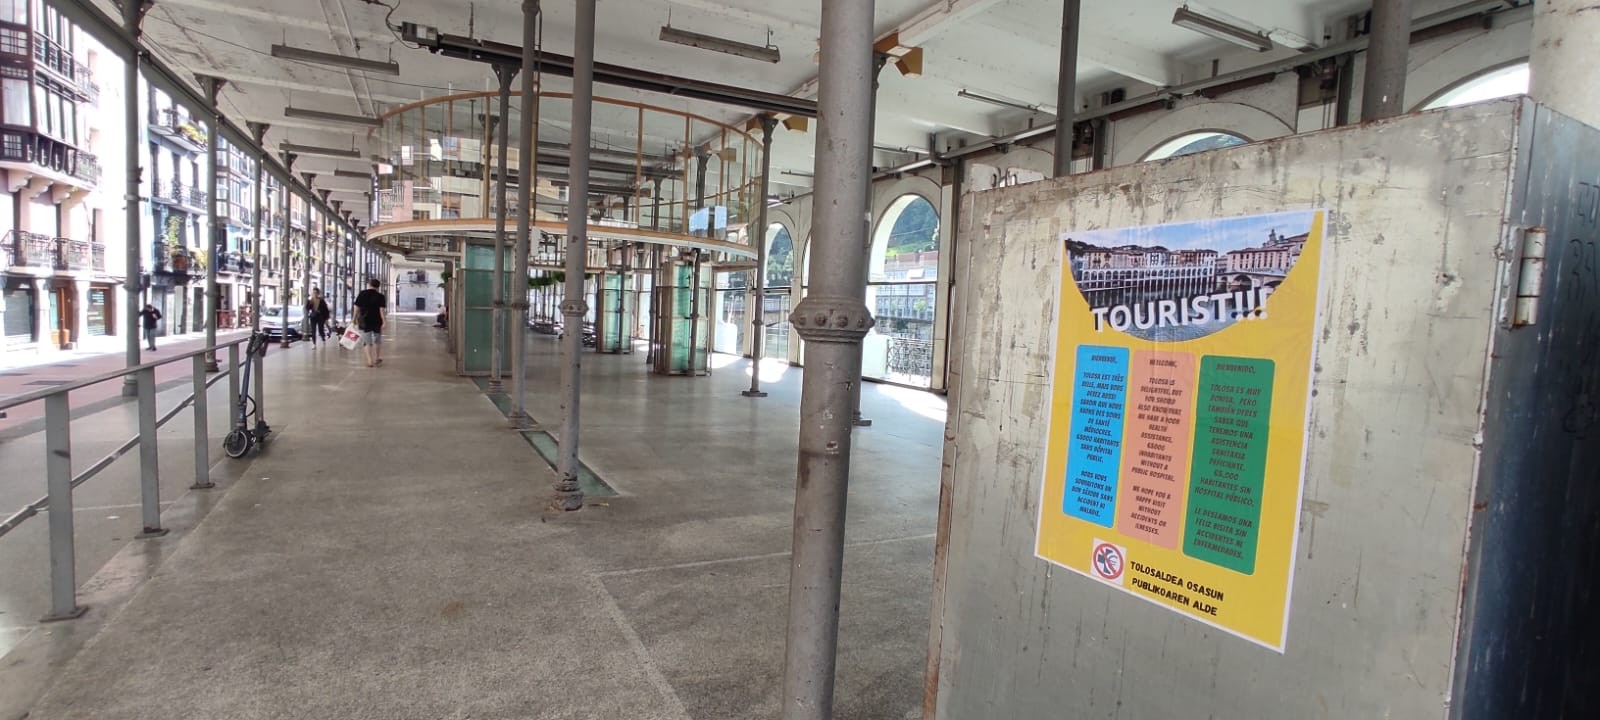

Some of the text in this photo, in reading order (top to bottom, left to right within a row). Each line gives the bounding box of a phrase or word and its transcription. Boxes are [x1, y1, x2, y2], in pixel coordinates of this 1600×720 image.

[1091, 284, 1269, 332] TOURIST!!!
[1211, 384, 1234, 392] TOLOSA
[1239, 398, 1256, 406] PERO
[1149, 424, 1168, 432] HEALTH
[1140, 460, 1163, 469] WITHOUT
[1132, 467, 1148, 475] PUBLIC
[1200, 477, 1238, 490] HABITANTES
[1195, 487, 1224, 499] HOSPITAL
[1136, 495, 1152, 504] HAPPY
[1138, 505, 1161, 516] WITHOUT
[1131, 512, 1158, 525] ACCIDENTS
[1235, 529, 1247, 538] SIN
[1131, 561, 1224, 601] TOLOSALDEA OSASUN
[1132, 578, 1218, 616] PUBLIKOAREN ALDE
